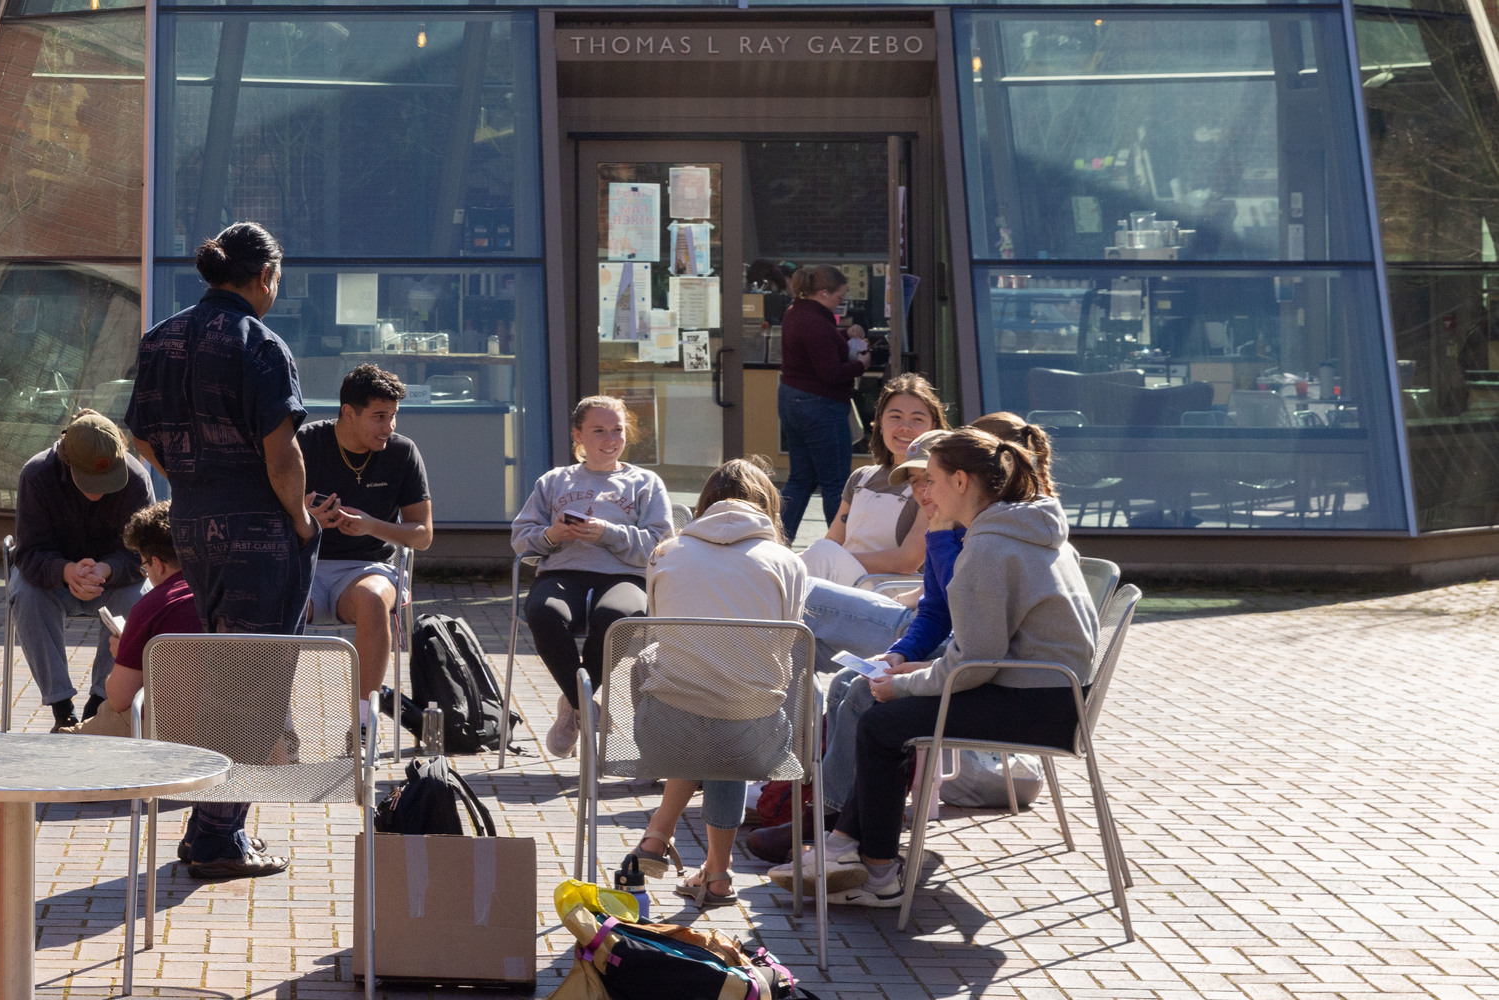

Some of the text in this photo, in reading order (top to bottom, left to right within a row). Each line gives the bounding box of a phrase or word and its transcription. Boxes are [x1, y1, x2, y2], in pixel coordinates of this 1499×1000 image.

[570, 36, 924, 55] THOMAS L RAY GAZEBO
[551, 489, 595, 514] ESTES
